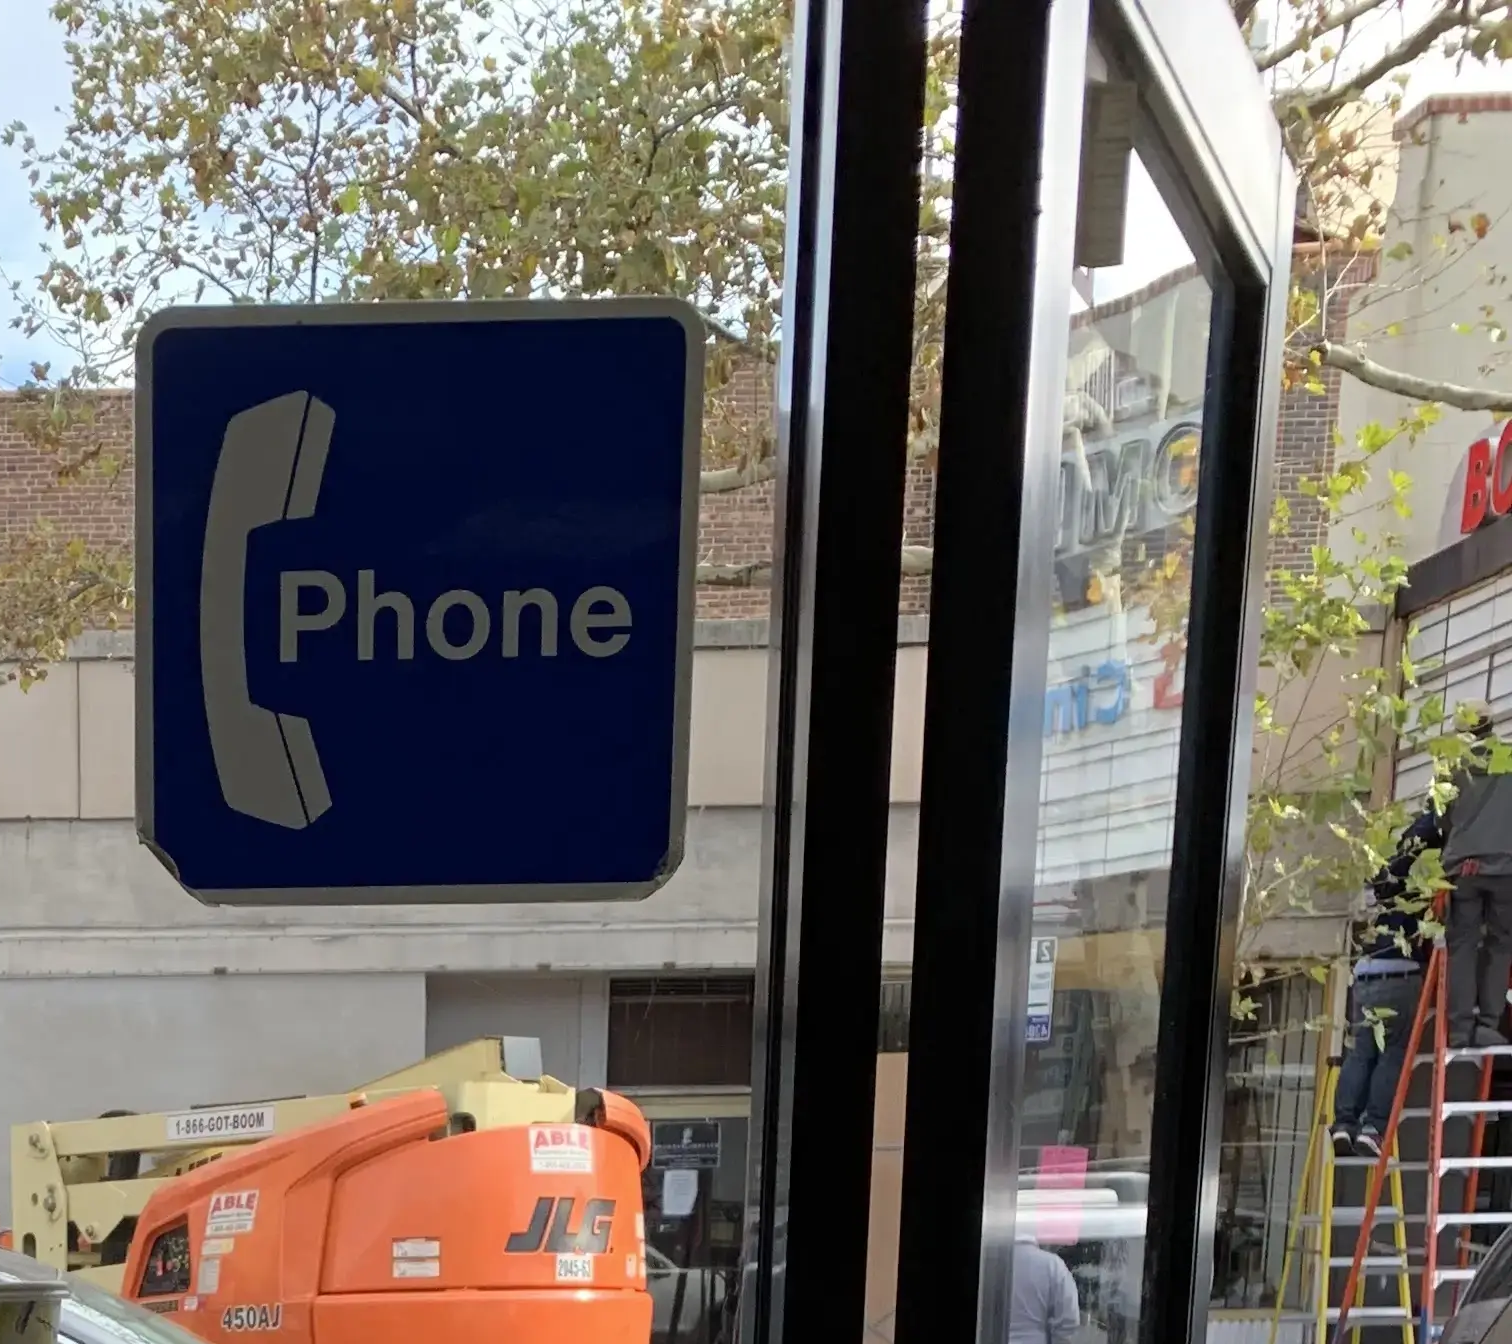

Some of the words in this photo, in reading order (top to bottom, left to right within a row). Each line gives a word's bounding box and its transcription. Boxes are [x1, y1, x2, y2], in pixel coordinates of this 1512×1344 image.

[279, 568, 633, 663] Phone
[176, 1111, 265, 1135] 1-866-GOT-BOOM
[535, 1130, 589, 1149] ABLE
[210, 1192, 257, 1214] ABLE
[504, 1197, 617, 1253] JLG
[223, 1303, 282, 1330] 450AJ
